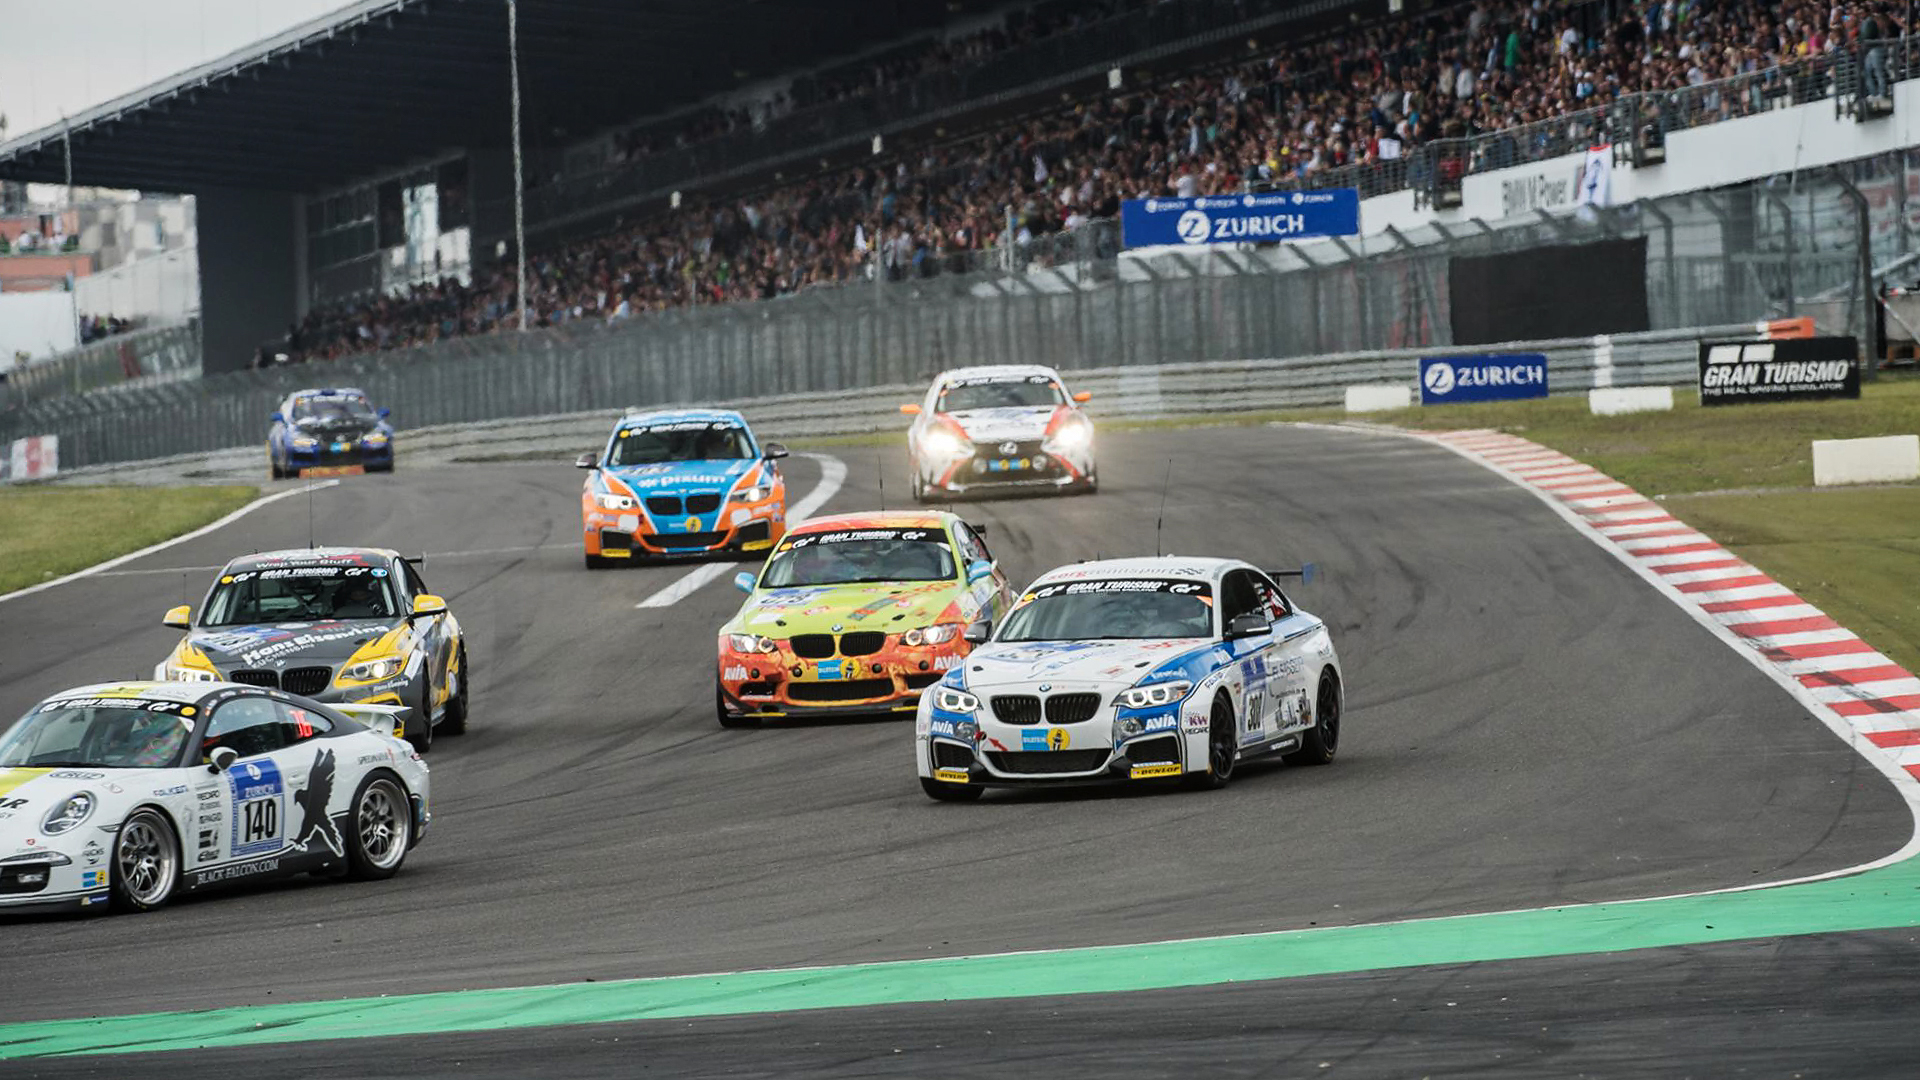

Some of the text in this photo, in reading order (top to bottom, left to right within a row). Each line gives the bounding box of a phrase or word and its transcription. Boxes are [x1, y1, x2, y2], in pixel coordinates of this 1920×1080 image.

[1213, 214, 1305, 238] ZURICH
[1457, 364, 1543, 386] ZURICH
[1703, 363, 1760, 387] GRAN
[1703, 387, 1722, 396] THE
[1724, 386, 1748, 394] REAL
[1066, 582, 1101, 591] GRAN
[241, 640, 295, 665] Hans
[1141, 766, 1180, 776] DUNLOP
[244, 798, 277, 843] 140
